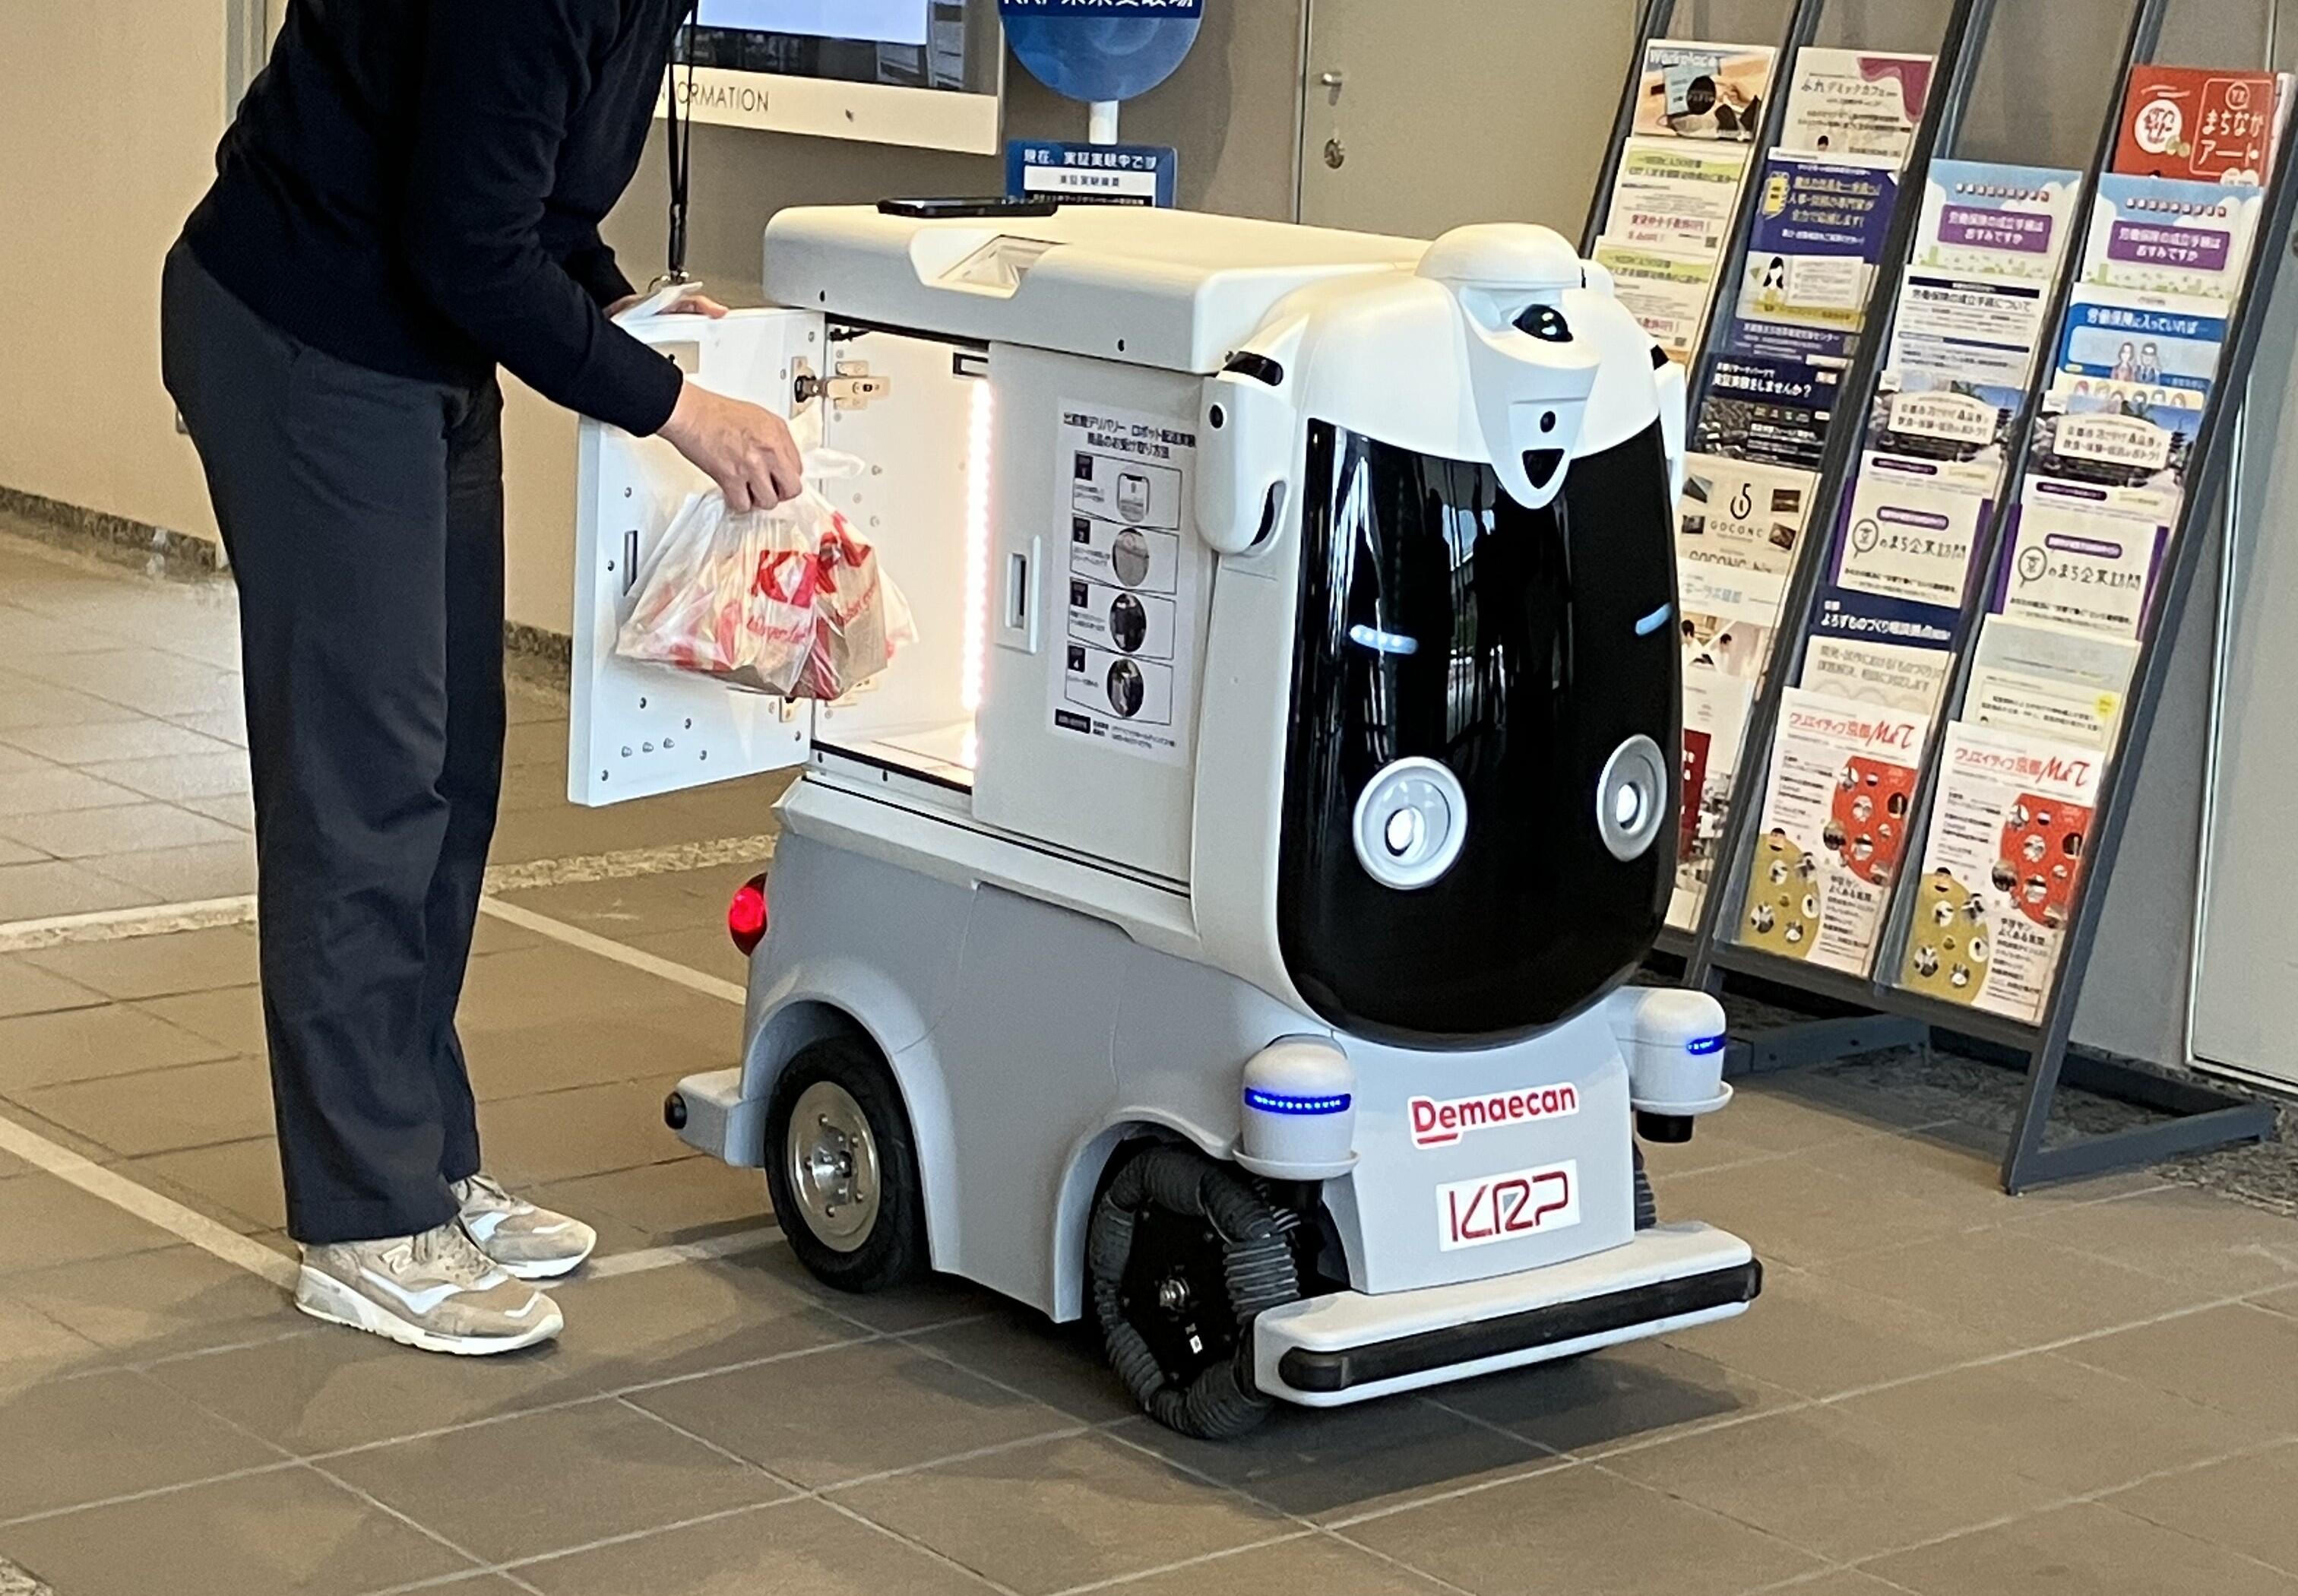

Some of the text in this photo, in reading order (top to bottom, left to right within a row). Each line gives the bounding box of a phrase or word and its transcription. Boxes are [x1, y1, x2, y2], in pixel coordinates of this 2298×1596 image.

[662, 81, 768, 112] ORMATION
[2201, 108, 2264, 137] まちなか
[2198, 139, 2259, 168] アート
[1411, 1087, 1576, 1133] Demaecan
